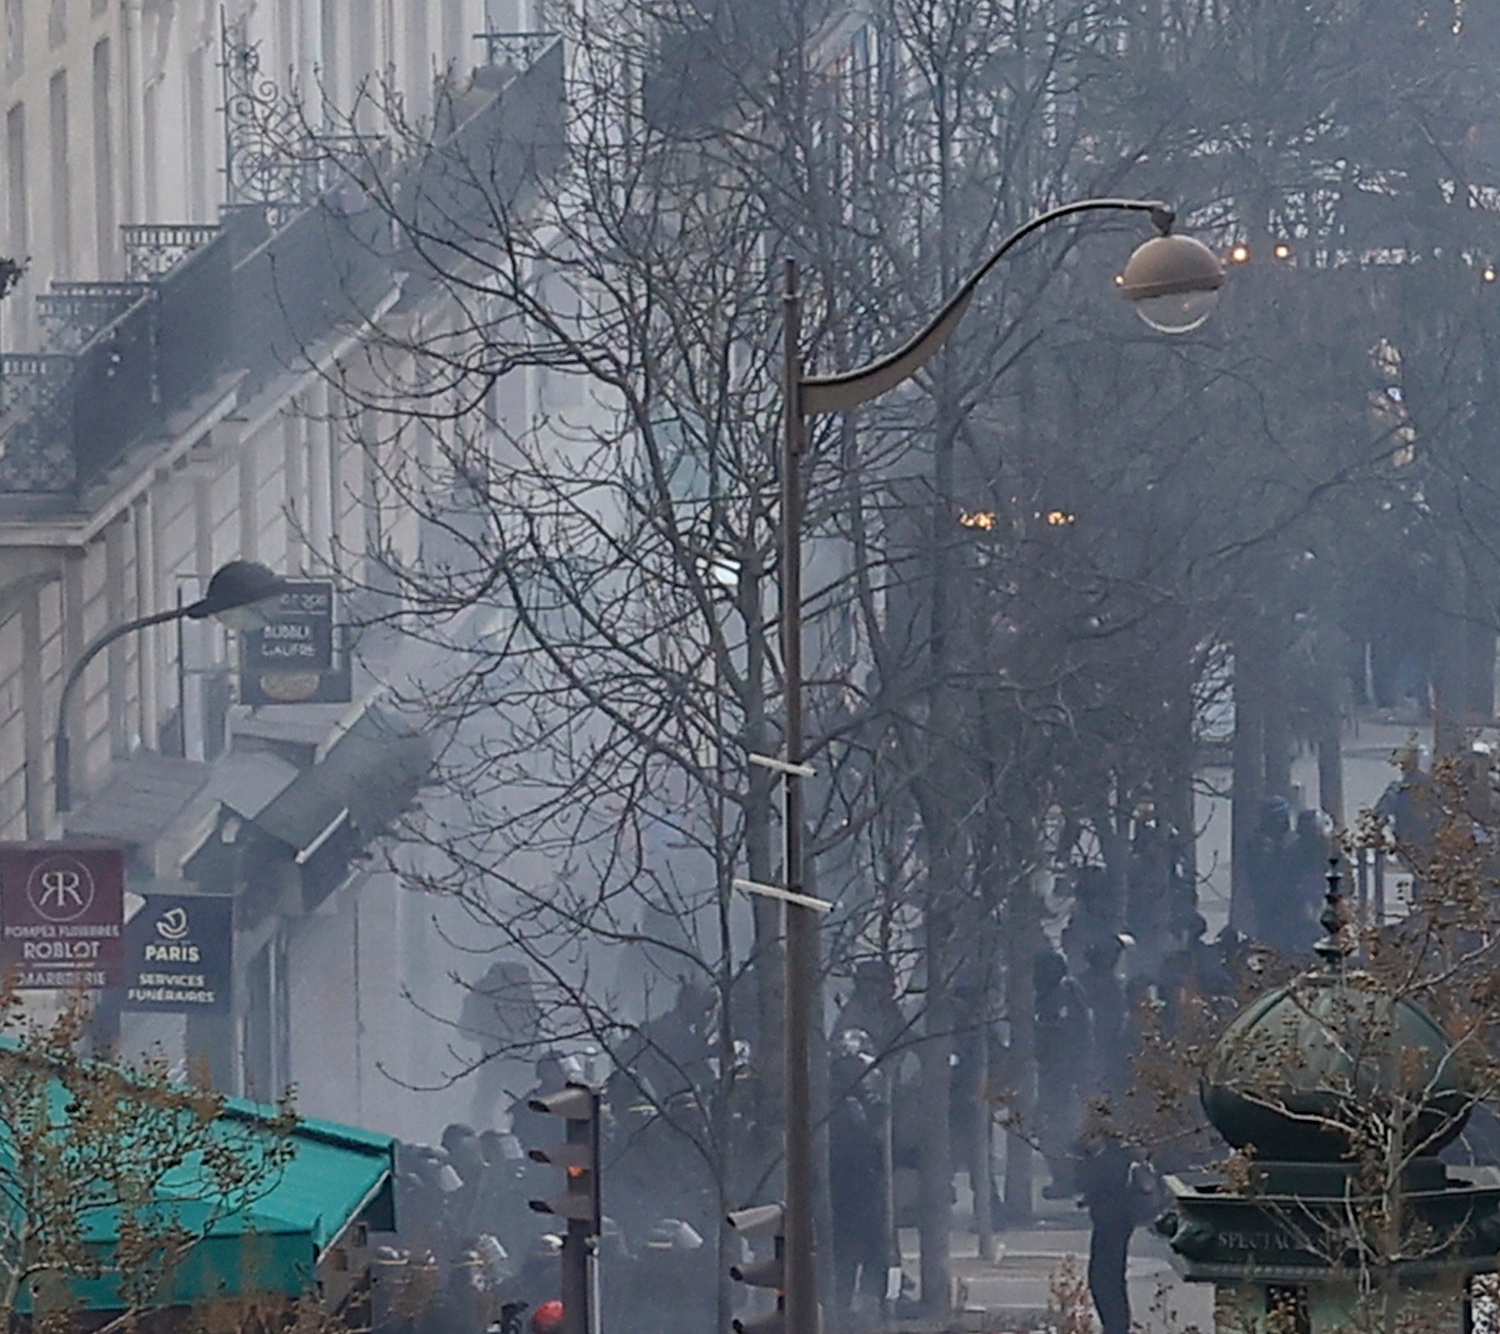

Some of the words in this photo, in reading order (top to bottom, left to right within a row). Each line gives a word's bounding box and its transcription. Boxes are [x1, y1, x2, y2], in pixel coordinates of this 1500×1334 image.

[23, 941, 100, 960] ROBLOT
[145, 945, 200, 963] PARIS
[139, 973, 206, 987] SERVICES
